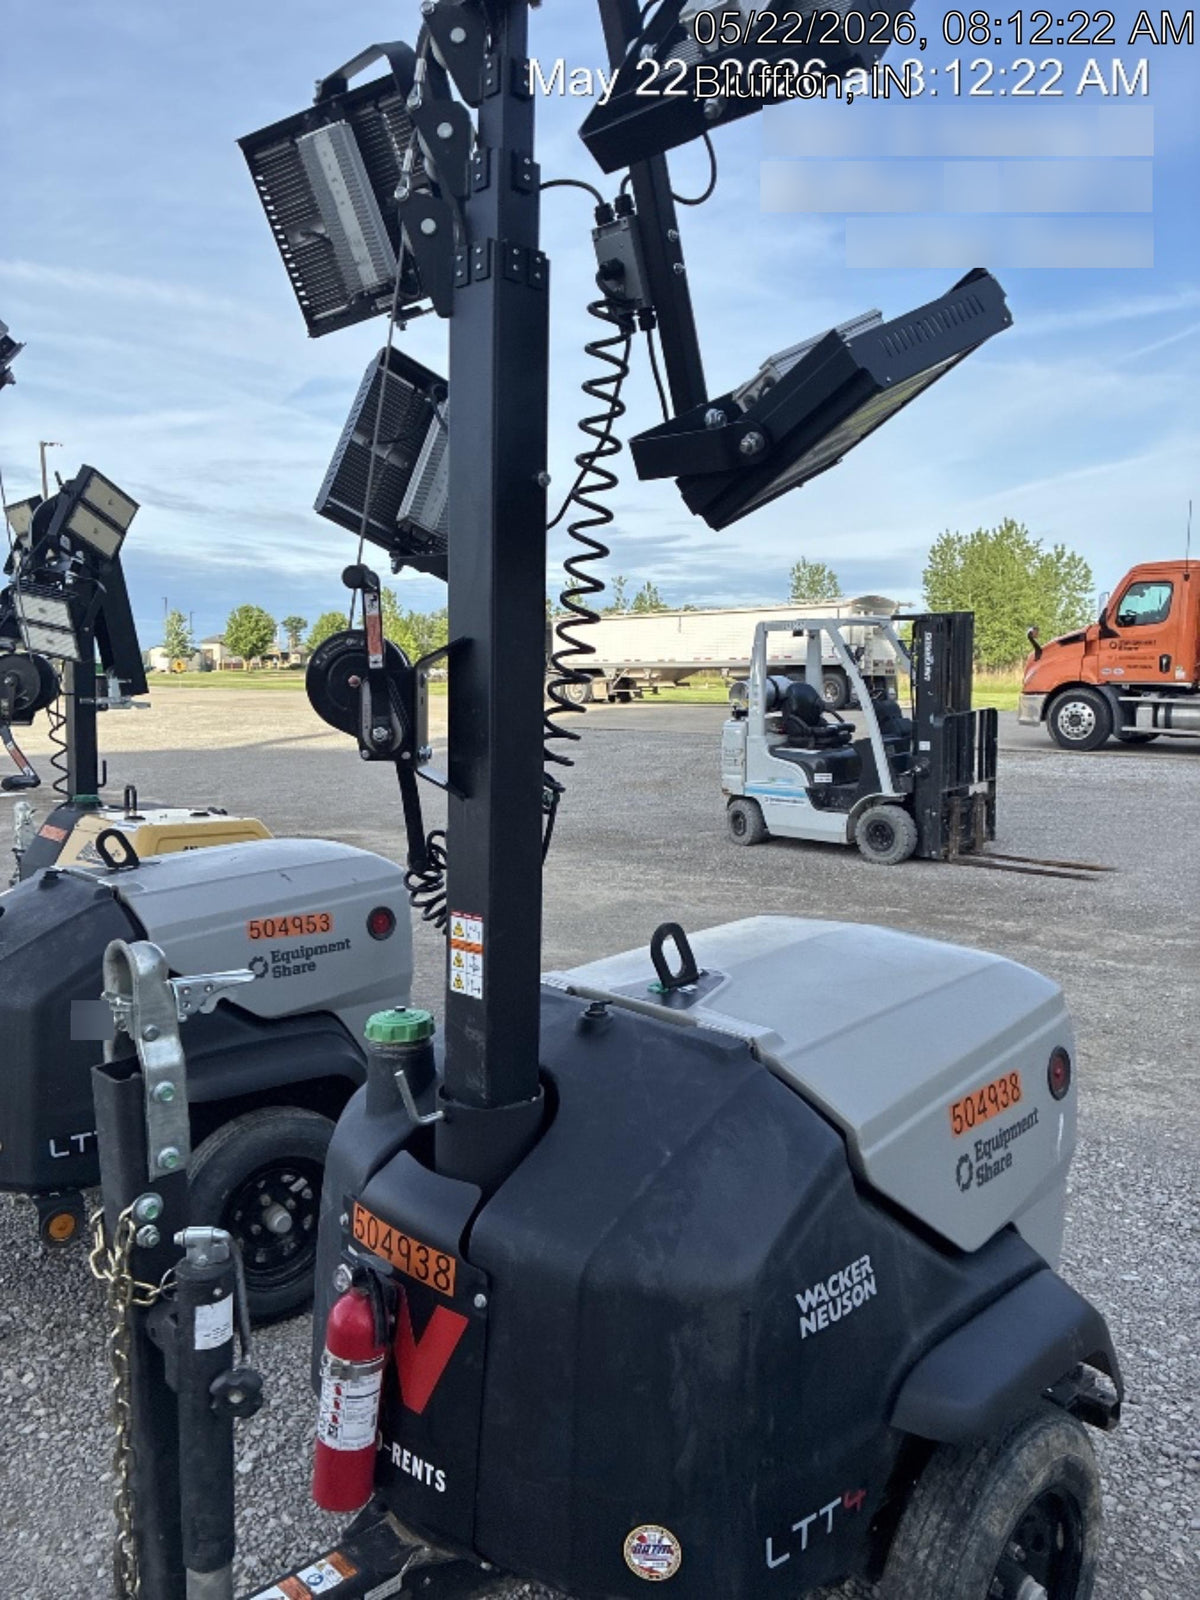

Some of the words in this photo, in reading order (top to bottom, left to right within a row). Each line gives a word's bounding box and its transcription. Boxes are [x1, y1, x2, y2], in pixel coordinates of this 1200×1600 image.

[250, 913, 330, 940] 504953
[270, 938, 351, 964] Equipment
[271, 961, 317, 979] Share
[952, 1073, 1021, 1135] 504938
[974, 1106, 1039, 1163] Equipment
[976, 1152, 1013, 1188] Share
[355, 1207, 451, 1291] 504938
[796, 1254, 873, 1313] WACKER
[800, 1275, 877, 1339] NEUSON
